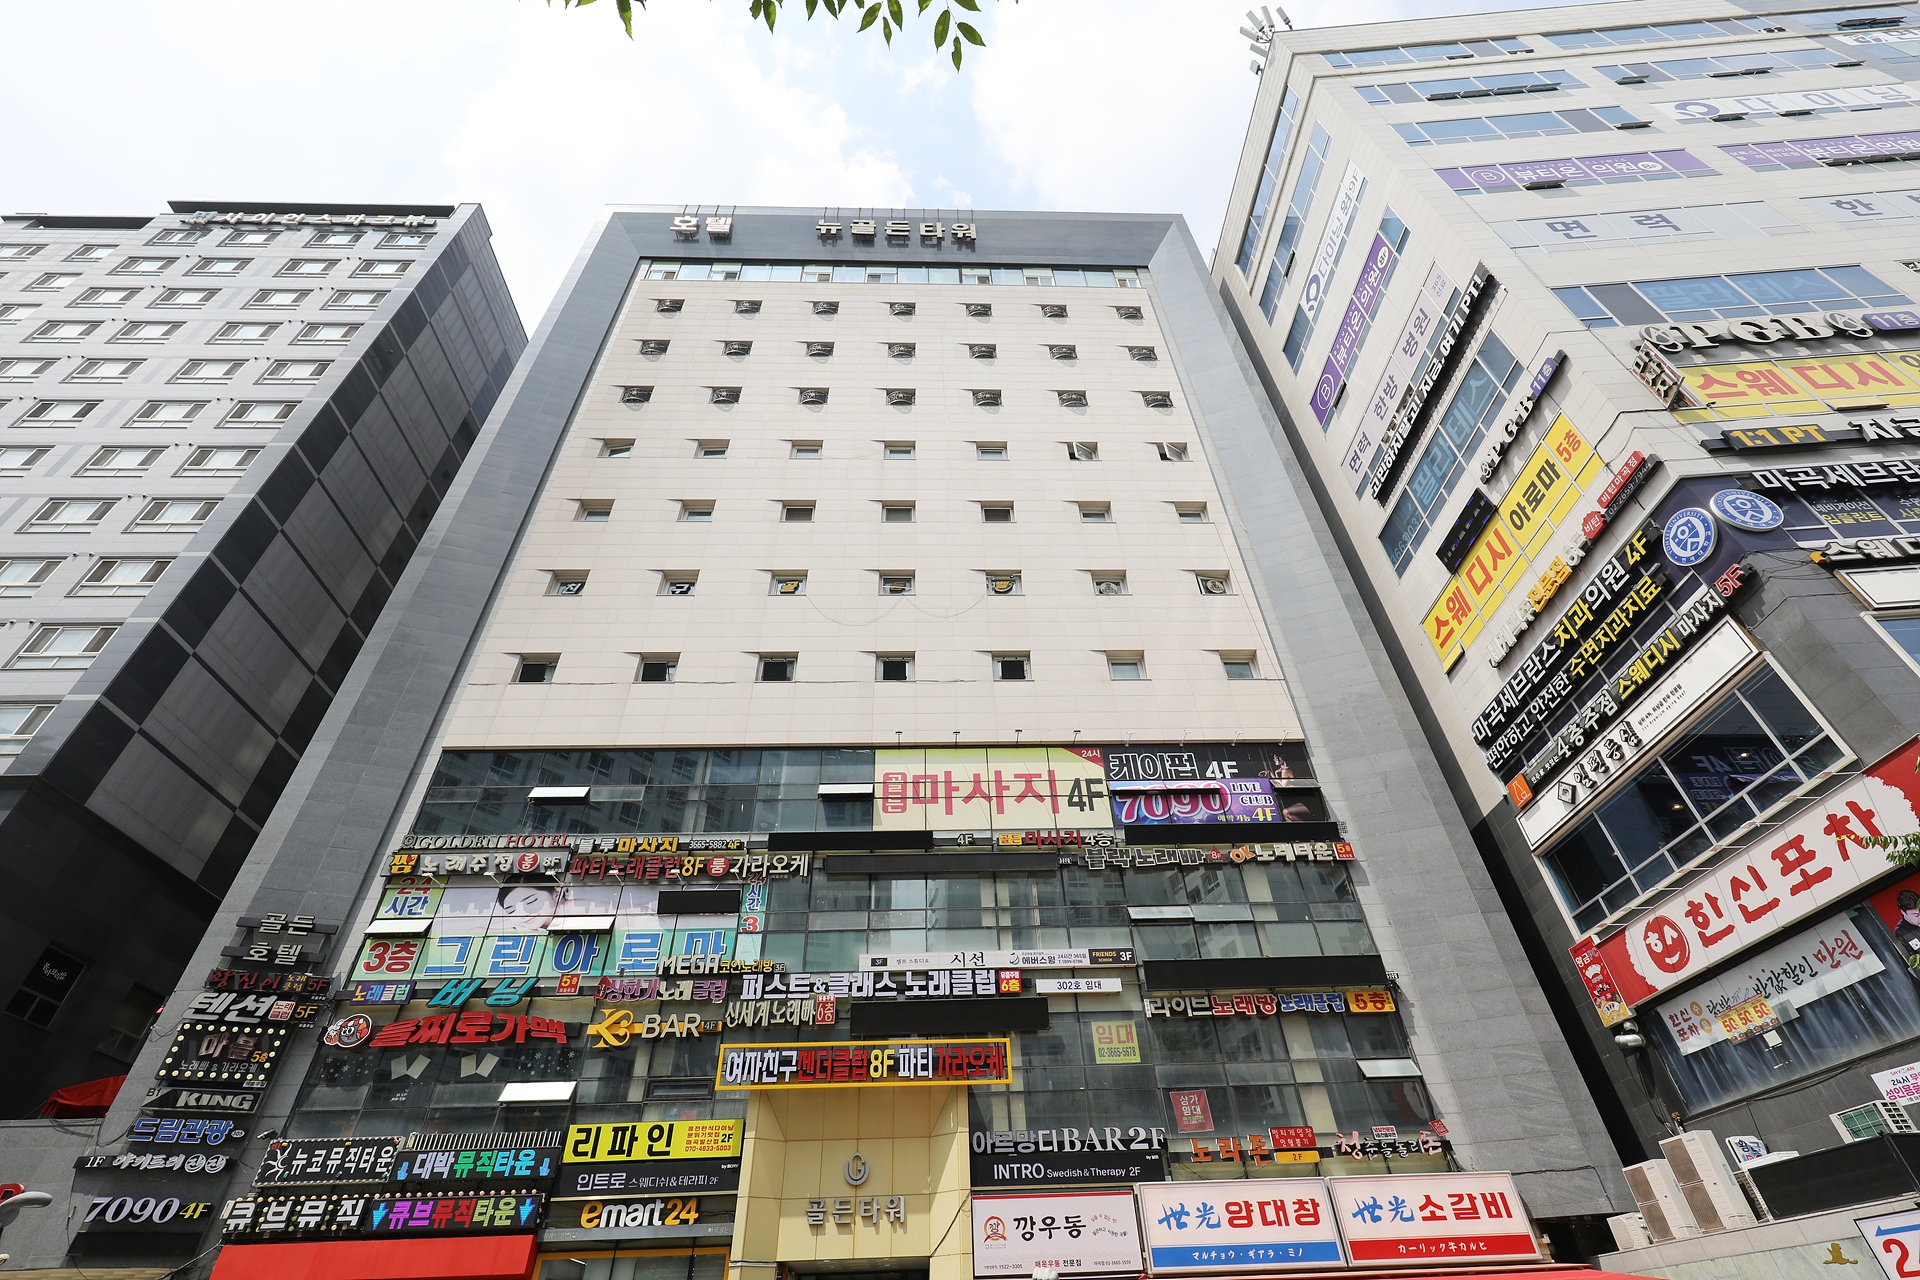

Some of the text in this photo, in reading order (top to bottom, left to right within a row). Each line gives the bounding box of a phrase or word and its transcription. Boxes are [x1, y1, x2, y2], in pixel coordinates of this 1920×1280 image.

[1734, 85, 1909, 113] 다이닝
[1584, 156, 1628, 165] CLINIC
[1808, 141, 1874, 160] 뷰티온
[1516, 158, 1641, 182] 뷰티온 의원
[219, 212, 427, 227] 사이언스파크뷰
[669, 215, 733, 236] 호텔
[815, 218, 977, 241] 뉴골든타워
[1318, 216, 1343, 279] 다이닝
[1350, 169, 1360, 191] 9F
[1641, 275, 1841, 309] 필라테스
[1336, 267, 1381, 367] 뷰티온 의원
[1869, 311, 1919, 328] 11층
[1439, 316, 1466, 356] 여기
[1532, 363, 1555, 391] 11층
[1696, 360, 1905, 399] 스웨디시
[1349, 306, 1431, 474] 면력 한방 병원
[1412, 373, 1496, 505] 필라테스
[1729, 425, 1827, 447] 1:1 PT
[1812, 498, 1872, 513] 네비게이션
[1669, 510, 1704, 529] UNIVERSITY
[1822, 511, 1886, 526] 임플란트
[1434, 527, 1514, 649] 스웨디시
[1509, 457, 1562, 531] 아로마
[1555, 428, 1582, 463] 5층
[1472, 530, 1649, 742] 마곡세브란스치과의원 4F
[1617, 628, 1681, 700] 스웨디시
[1677, 586, 1726, 636] 마사지
[1715, 563, 1746, 597] 5F
[1488, 575, 1662, 769] 편안하고 안전한 수면치과치료
[1109, 752, 1238, 780] 케이펍 4F
[885, 769, 1104, 815] 골든 마사지 4F
[1116, 782, 1262, 823] 7090 LIVE
[1239, 795, 1273, 806] CLUB
[1252, 807, 1277, 822] 4F
[414, 834, 571, 849] GOLDEN HOTEL
[578, 838, 616, 854] 블루
[617, 837, 679, 853] 마사지
[727, 840, 741, 849] 4F
[957, 834, 974, 845] 4F
[999, 830, 1112, 848] 골든 마사지 4층
[542, 855, 561, 867] 8F
[568, 853, 809, 880] 파티노래클럽 8F 룸 가라오케
[1230, 845, 1255, 863] OK
[1685, 800, 1891, 948] 한신포차
[384, 895, 430, 916] 시간
[746, 884, 762, 912] 시간
[259, 912, 315, 936] 골든
[242, 941, 303, 966] 호텔
[361, 929, 727, 976] 3층 그린아로마
[950, 951, 986, 967] 시선
[1119, 951, 1133, 962] 3F
[1812, 929, 1864, 969] 만원
[657, 953, 720, 976] MEGA
[719, 959, 774, 973] 코인노래방
[307, 978, 330, 991] 5F
[352, 977, 540, 1007] 노래클럽 버닝
[740, 969, 996, 999] 퍼스트&클래스 노래클럽
[1001, 979, 1020, 992] 6층
[1056, 981, 1102, 990] 302호 임대
[182, 992, 279, 1024] 텐션
[295, 1005, 318, 1019] 5F
[724, 999, 834, 1028] 신세계노래빠 6층
[1150, 995, 1212, 1017] 라이브
[1354, 993, 1386, 1011] 5층
[1668, 1007, 1692, 1028] 한신
[368, 1011, 568, 1048] 을찌로가맥
[641, 1013, 717, 1039] BAR 4F
[1095, 1024, 1135, 1046] 임대
[1677, 1022, 1700, 1042] 포차
[724, 1044, 1005, 1084] 여자친구 8F 파티 가라오케
[1890, 1075, 1911, 1086] 24시
[147, 1087, 255, 1110] B1 KING
[1179, 1094, 1199, 1106] 상가
[1181, 1105, 1202, 1116] 임대
[127, 1118, 234, 1146] 드림관광
[572, 1123, 675, 1159] 리파인
[720, 1133, 734, 1144] 2F
[1061, 1127, 1127, 1152] BAR
[1128, 1126, 1166, 1150] 2F
[84, 1156, 107, 1169] 1F
[291, 1145, 394, 1176] 뉴코뮤직타운
[1189, 1134, 1270, 1166] 노라존
[1292, 1152, 1303, 1161] 2F
[412, 1149, 536, 1179] 대박뮤직타운
[993, 1163, 1141, 1180] INTRO 2F
[576, 1172, 719, 1191] 인트로 2F
[83, 1196, 212, 1224] 7090 4F
[225, 1199, 366, 1233] 큐브뮤직
[388, 1197, 517, 1230] 큐브뮤직타운
[805, 1195, 905, 1225] 골든타워
[1225, 1198, 1321, 1229] 양대창
[1418, 1192, 1514, 1223] 소갈비
[1013, 1215, 1087, 1242] 깡우동
[1062, 1258, 1082, 1267] 전문점
